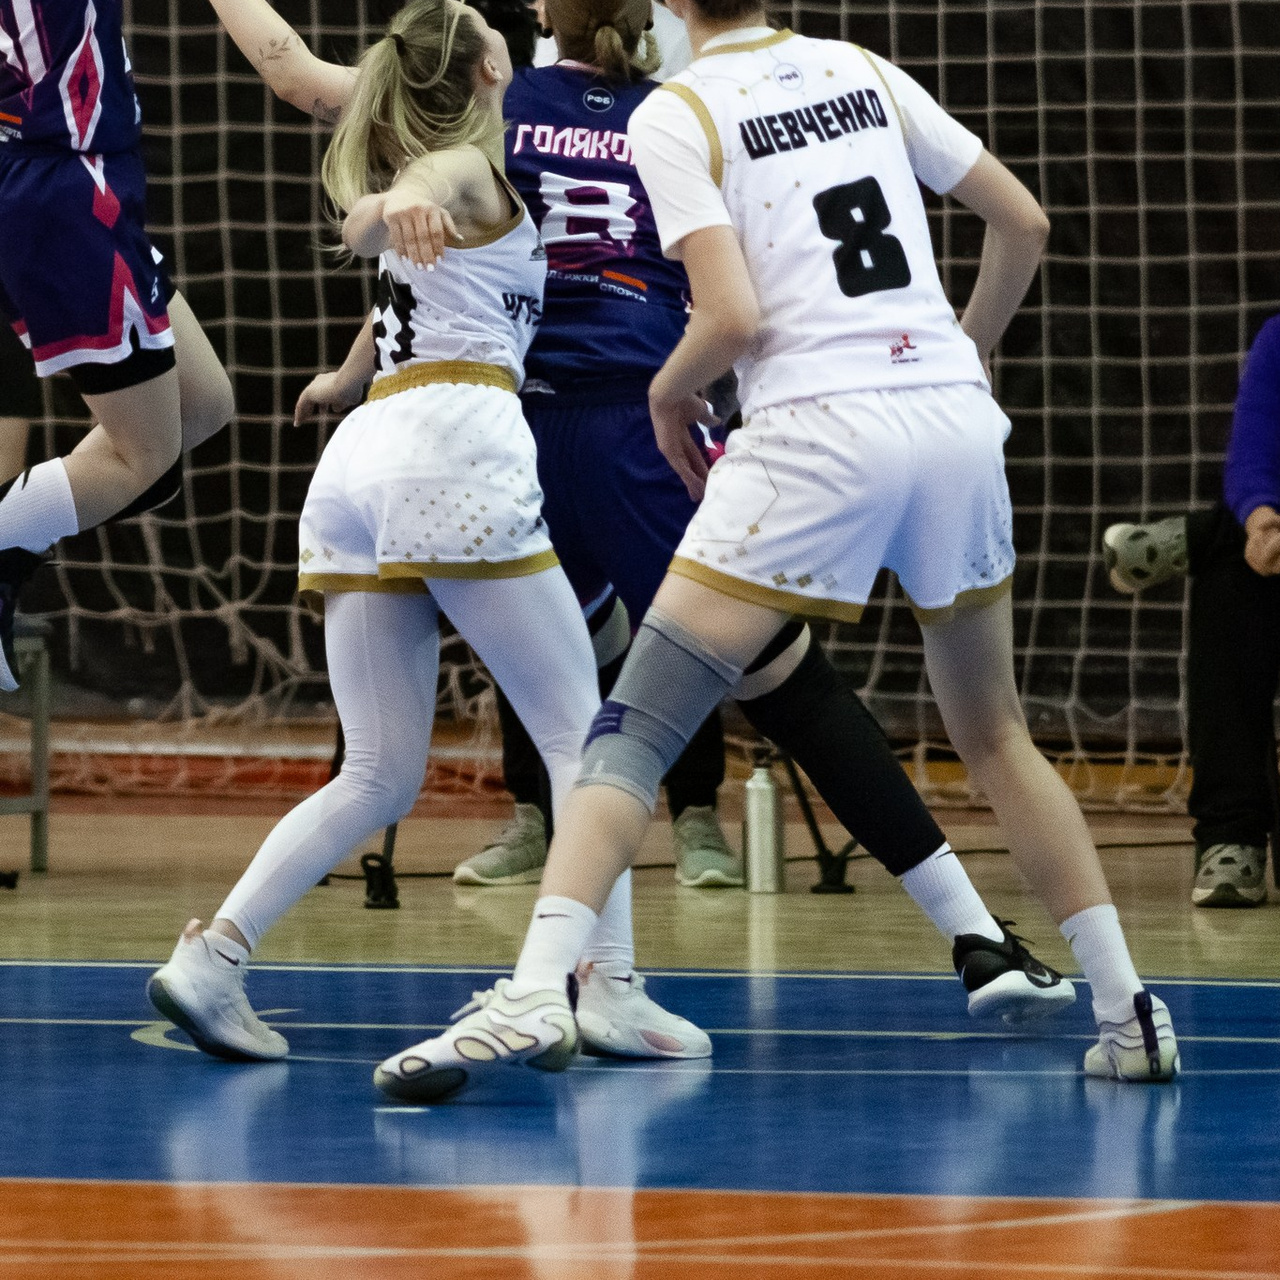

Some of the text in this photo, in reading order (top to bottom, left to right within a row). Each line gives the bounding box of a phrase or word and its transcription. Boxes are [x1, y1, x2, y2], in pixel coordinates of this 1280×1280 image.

[513, 124, 635, 164] ГОЛЯКО
[739, 89, 888, 160] ШЕВЧЕНКО
[812, 175, 912, 298] 8
[548, 269, 599, 283] ДЕРЖКИ
